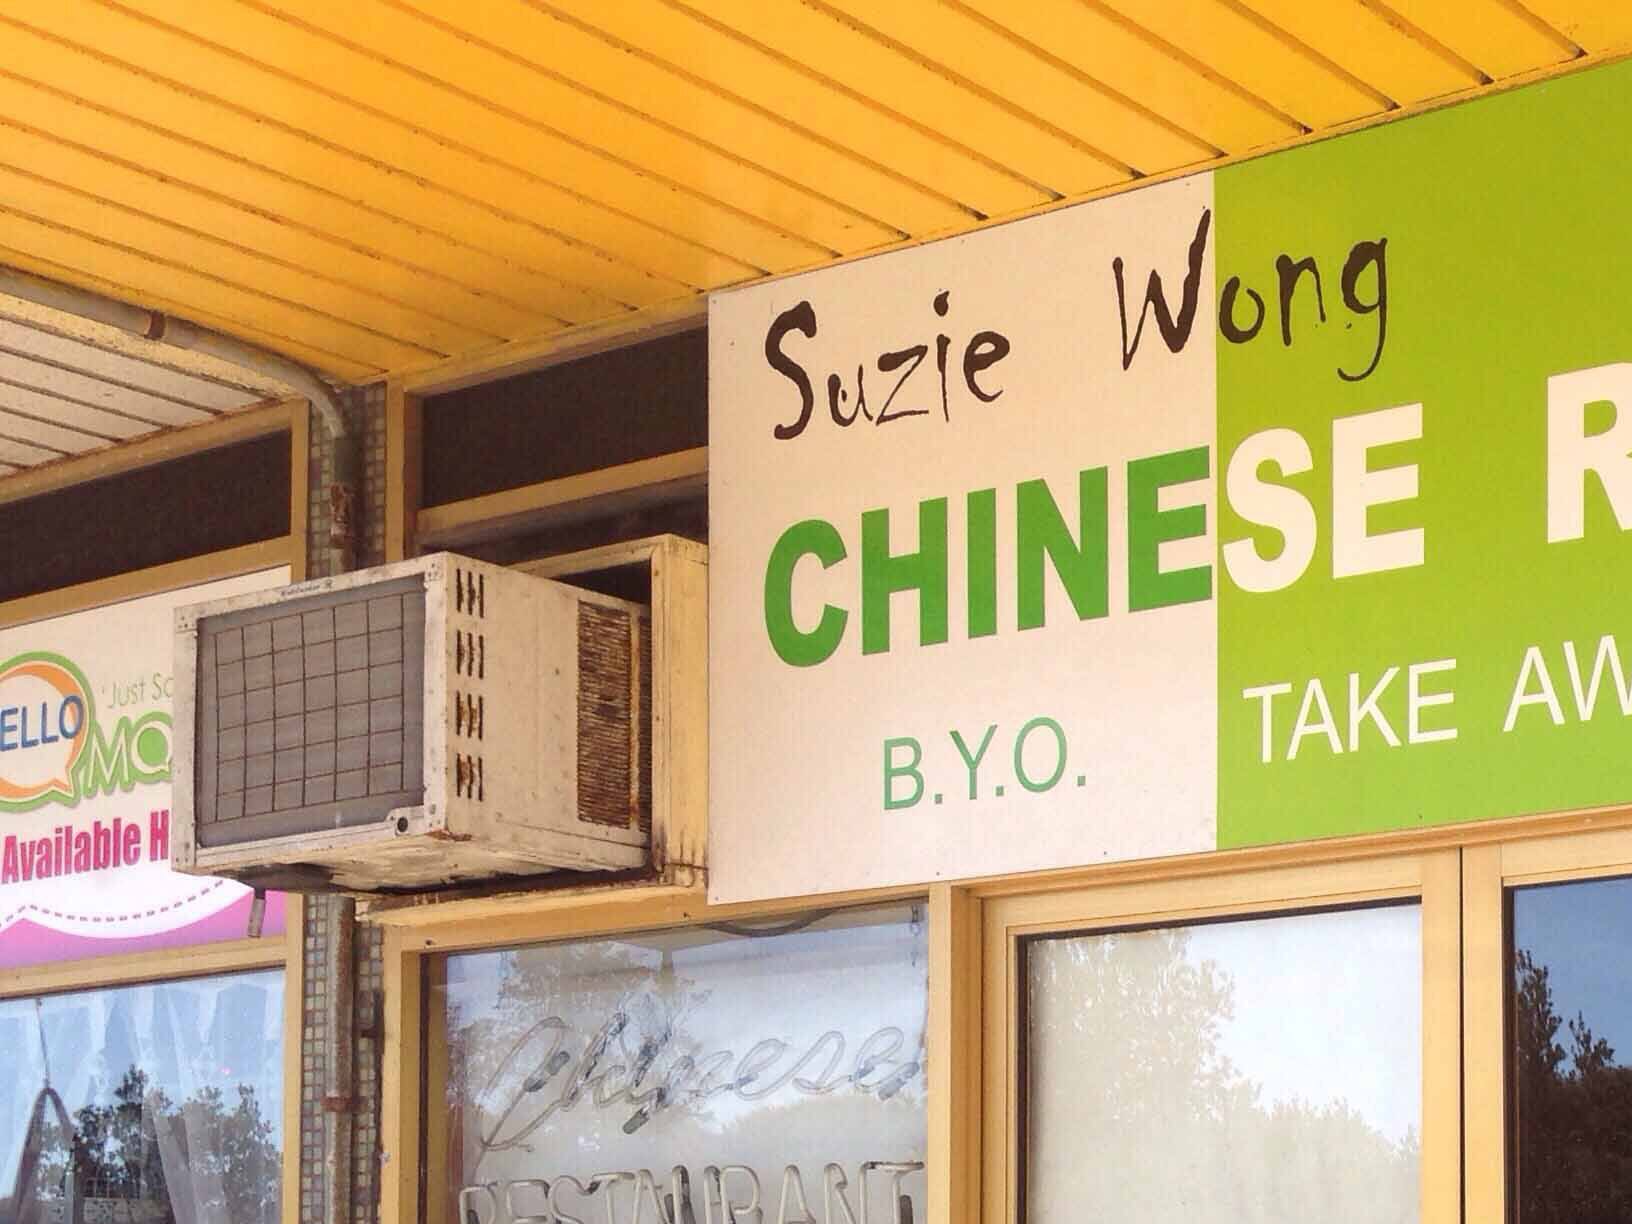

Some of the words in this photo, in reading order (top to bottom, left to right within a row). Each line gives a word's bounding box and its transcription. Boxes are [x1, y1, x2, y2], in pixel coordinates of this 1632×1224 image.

[764, 290, 1010, 440] Suzie
[1112, 208, 1388, 382] Wong
[763, 402, 1425, 668] CHINESE
[883, 716, 1087, 811] B.Y.O.
[1242, 659, 1458, 764] TAKE
[1, 817, 142, 885] Available
